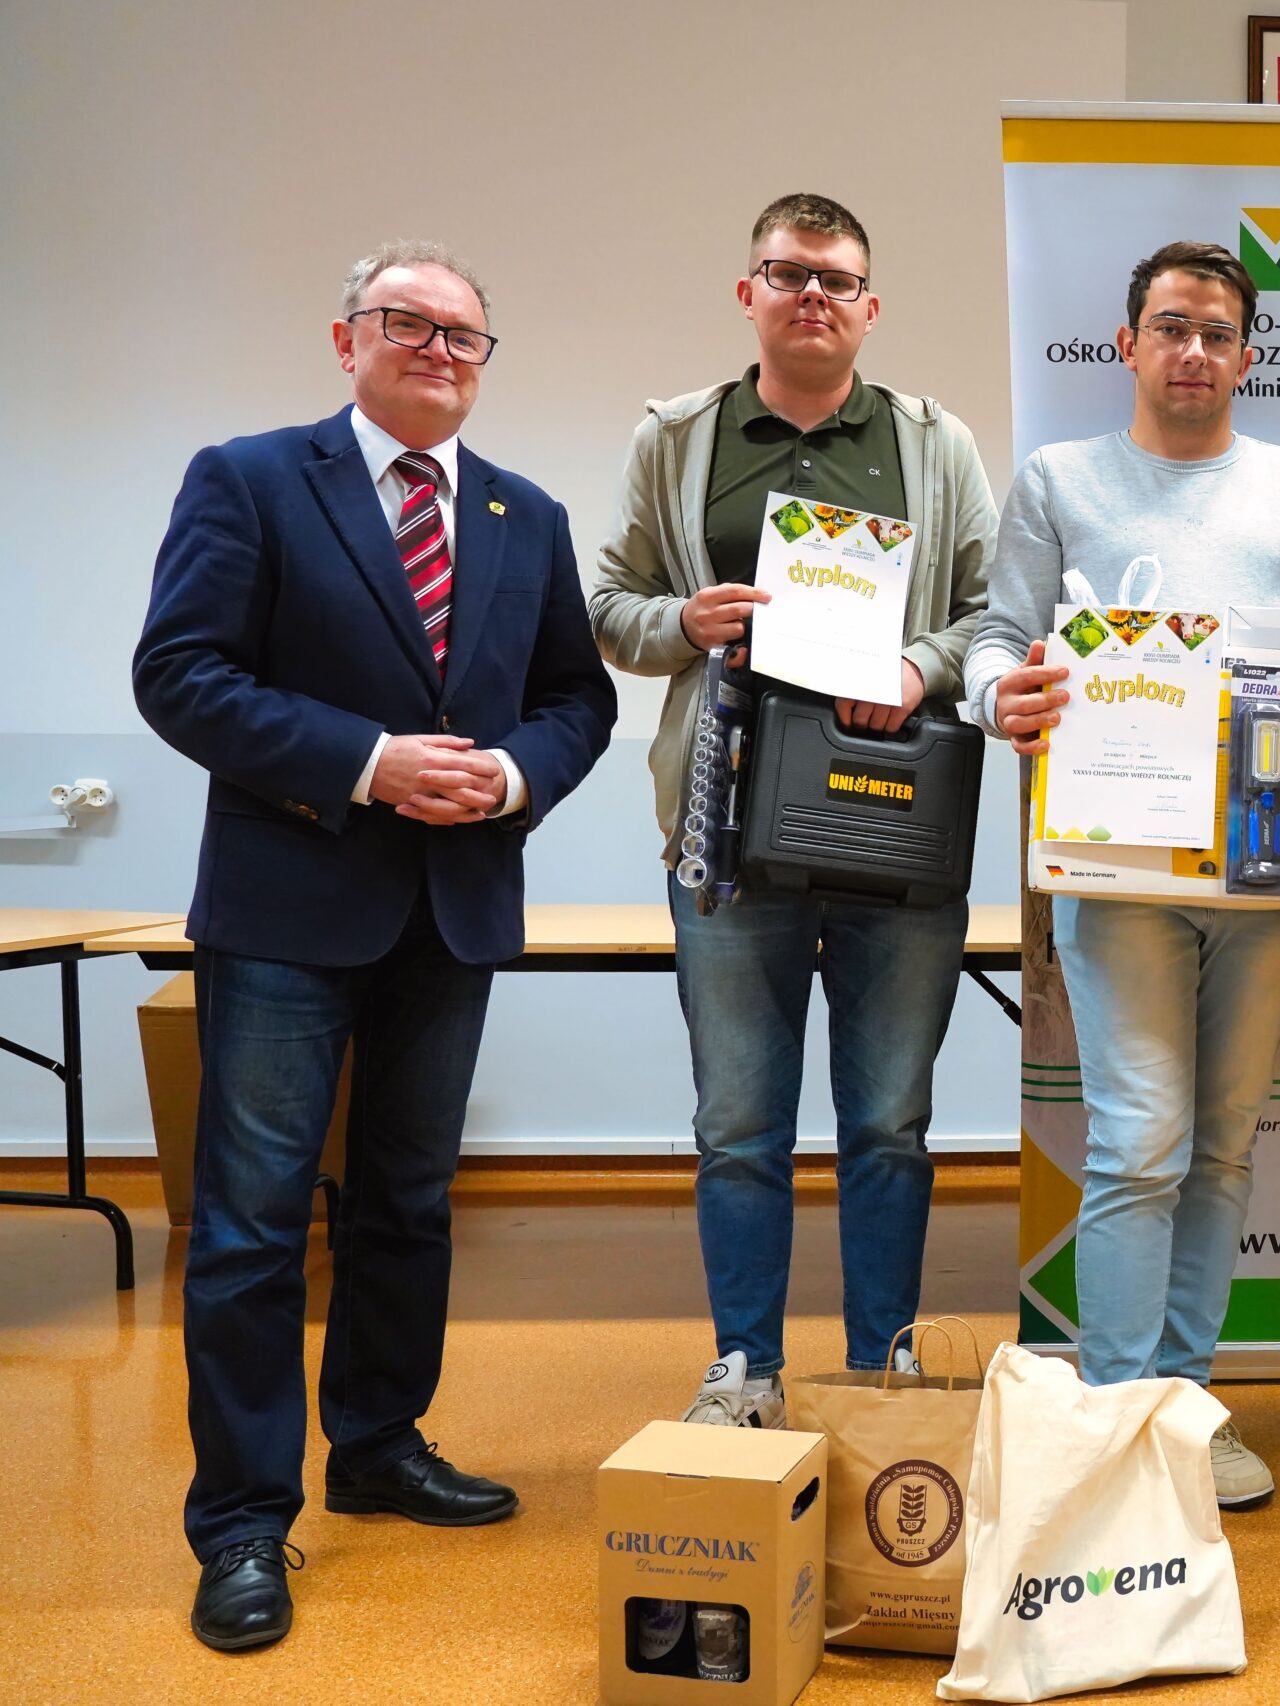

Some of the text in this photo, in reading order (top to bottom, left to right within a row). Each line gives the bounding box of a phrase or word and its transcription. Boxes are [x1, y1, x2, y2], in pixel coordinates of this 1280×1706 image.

[868, 468, 881, 476] CK
[787, 560, 877, 599] dyplom
[1085, 673, 1186, 708] dyplom
[1242, 683, 1278, 696] DEDRA
[1093, 770, 1129, 778] OLIMPIADY
[828, 773, 914, 800] UNI METER
[905, 1521, 917, 1529] GS
[605, 1530, 757, 1562] GRUCZNIAK
[907, 1551, 924, 1559] 1945
[870, 1591, 951, 1605] www.gspruszcz.pl
[911, 1608, 957, 1622] Mięsny
